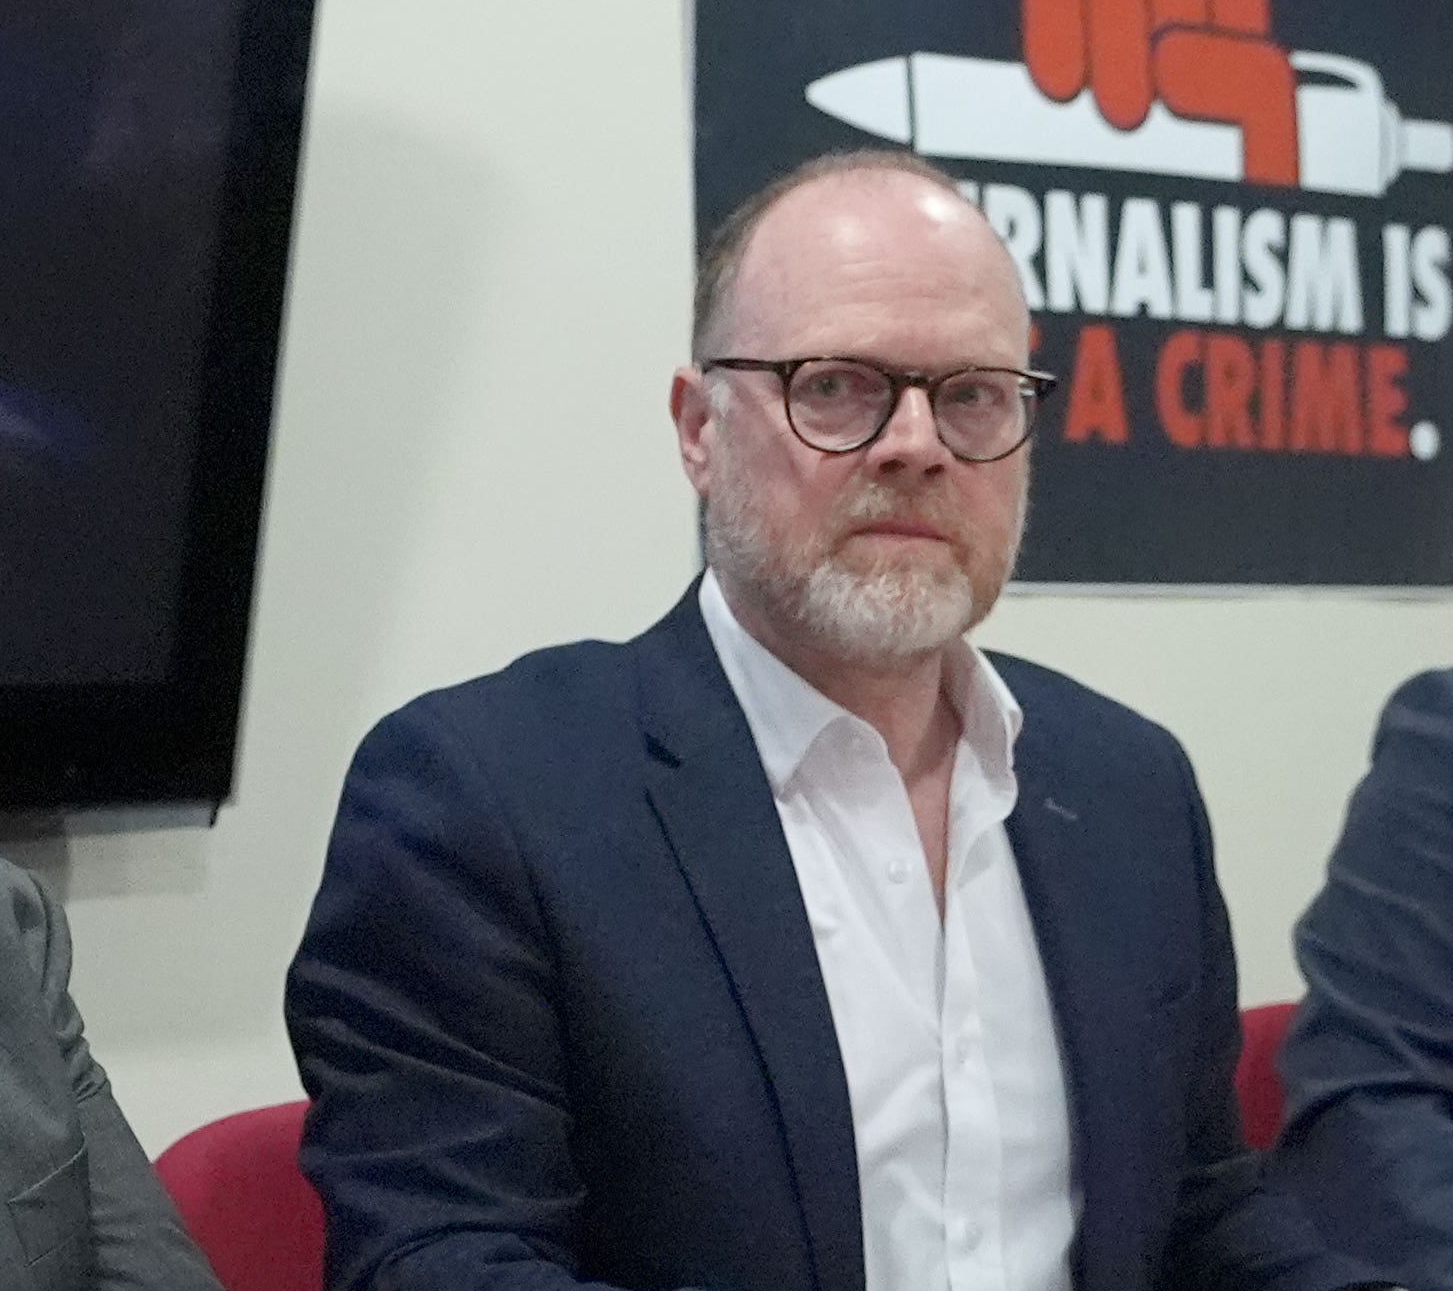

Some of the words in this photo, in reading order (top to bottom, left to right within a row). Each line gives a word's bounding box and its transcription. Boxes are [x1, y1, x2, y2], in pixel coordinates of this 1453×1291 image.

[958, 179, 1364, 336] RNALISM
[1064, 323, 1129, 444] A
[1155, 329, 1441, 461] CRIME.
